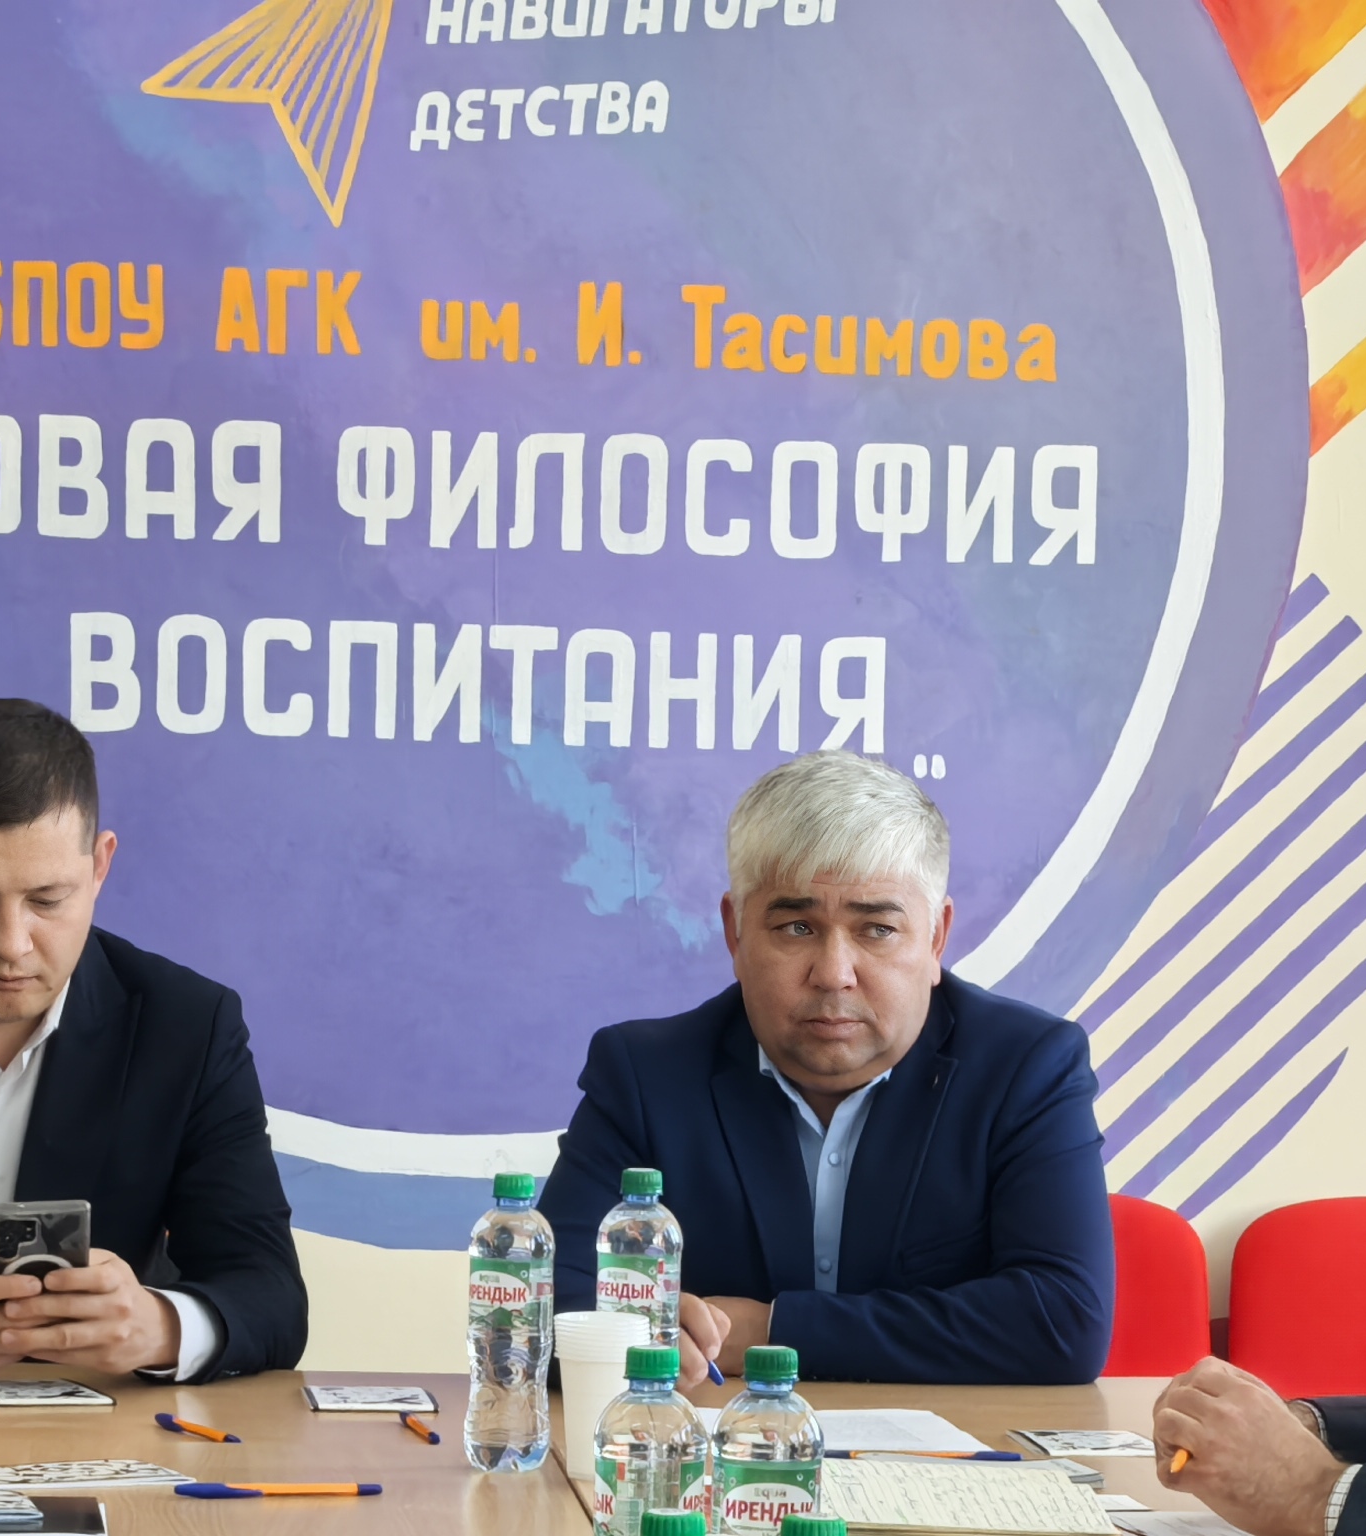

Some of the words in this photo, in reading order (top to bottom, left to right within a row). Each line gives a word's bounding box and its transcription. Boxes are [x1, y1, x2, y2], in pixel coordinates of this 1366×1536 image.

[409, 80, 669, 152] ДЕТСТВА
[215, 266, 362, 356] АГК
[576, 281, 642, 367] И.
[681, 284, 1058, 383] Тасимова
[336, 424, 1099, 567] ФИЛОСОФИЯ
[598, 1280, 655, 1302] РЕНДЫК
